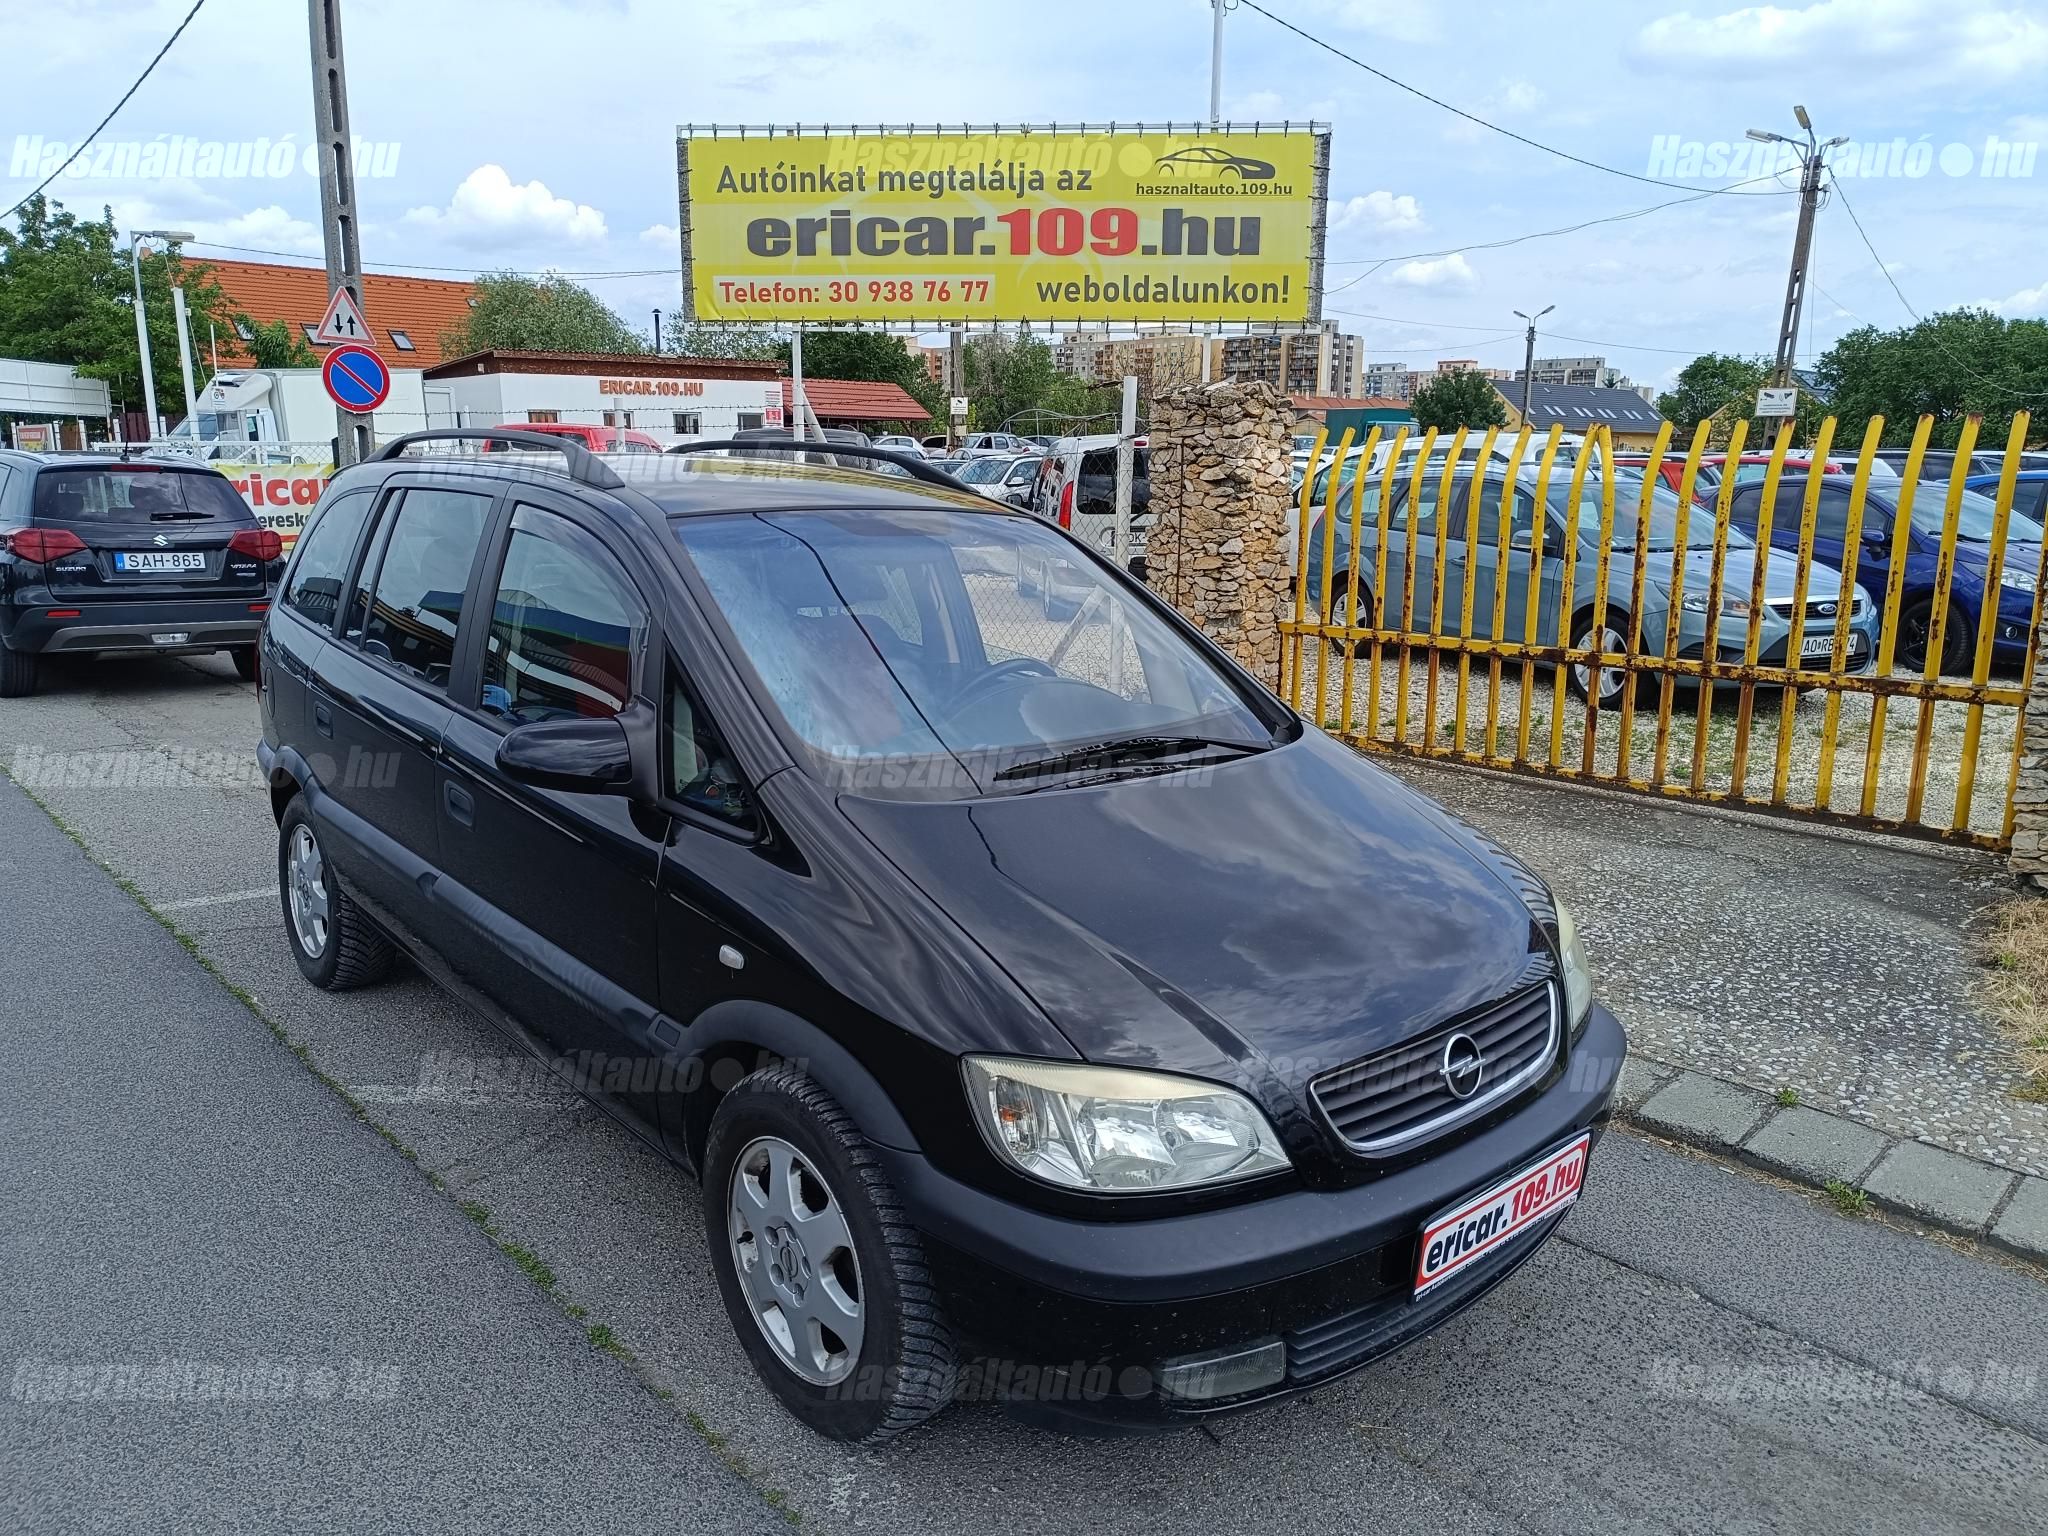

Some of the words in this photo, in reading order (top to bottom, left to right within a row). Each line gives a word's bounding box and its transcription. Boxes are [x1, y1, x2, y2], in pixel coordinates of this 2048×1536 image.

[716, 161, 866, 193] Autóinkat
[878, 159, 1044, 199] megtalálja
[1056, 169, 1092, 191] az
[1136, 183, 1292, 195] hasznaltauto.109.hu
[747, 207, 1261, 257] ericar.109.hu
[719, 281, 820, 303] Telefon:
[828, 281, 858, 303] 30
[867, 281, 914, 302] 938
[923, 280, 951, 302] 76
[960, 280, 989, 302] 77
[1036, 274, 1290, 304] weboldalunkon!
[599, 378, 704, 397] ERICAR.109.HU
[128, 553, 202, 568] SAH-865
[1425, 1156, 1580, 1273] ericar.109.hu
